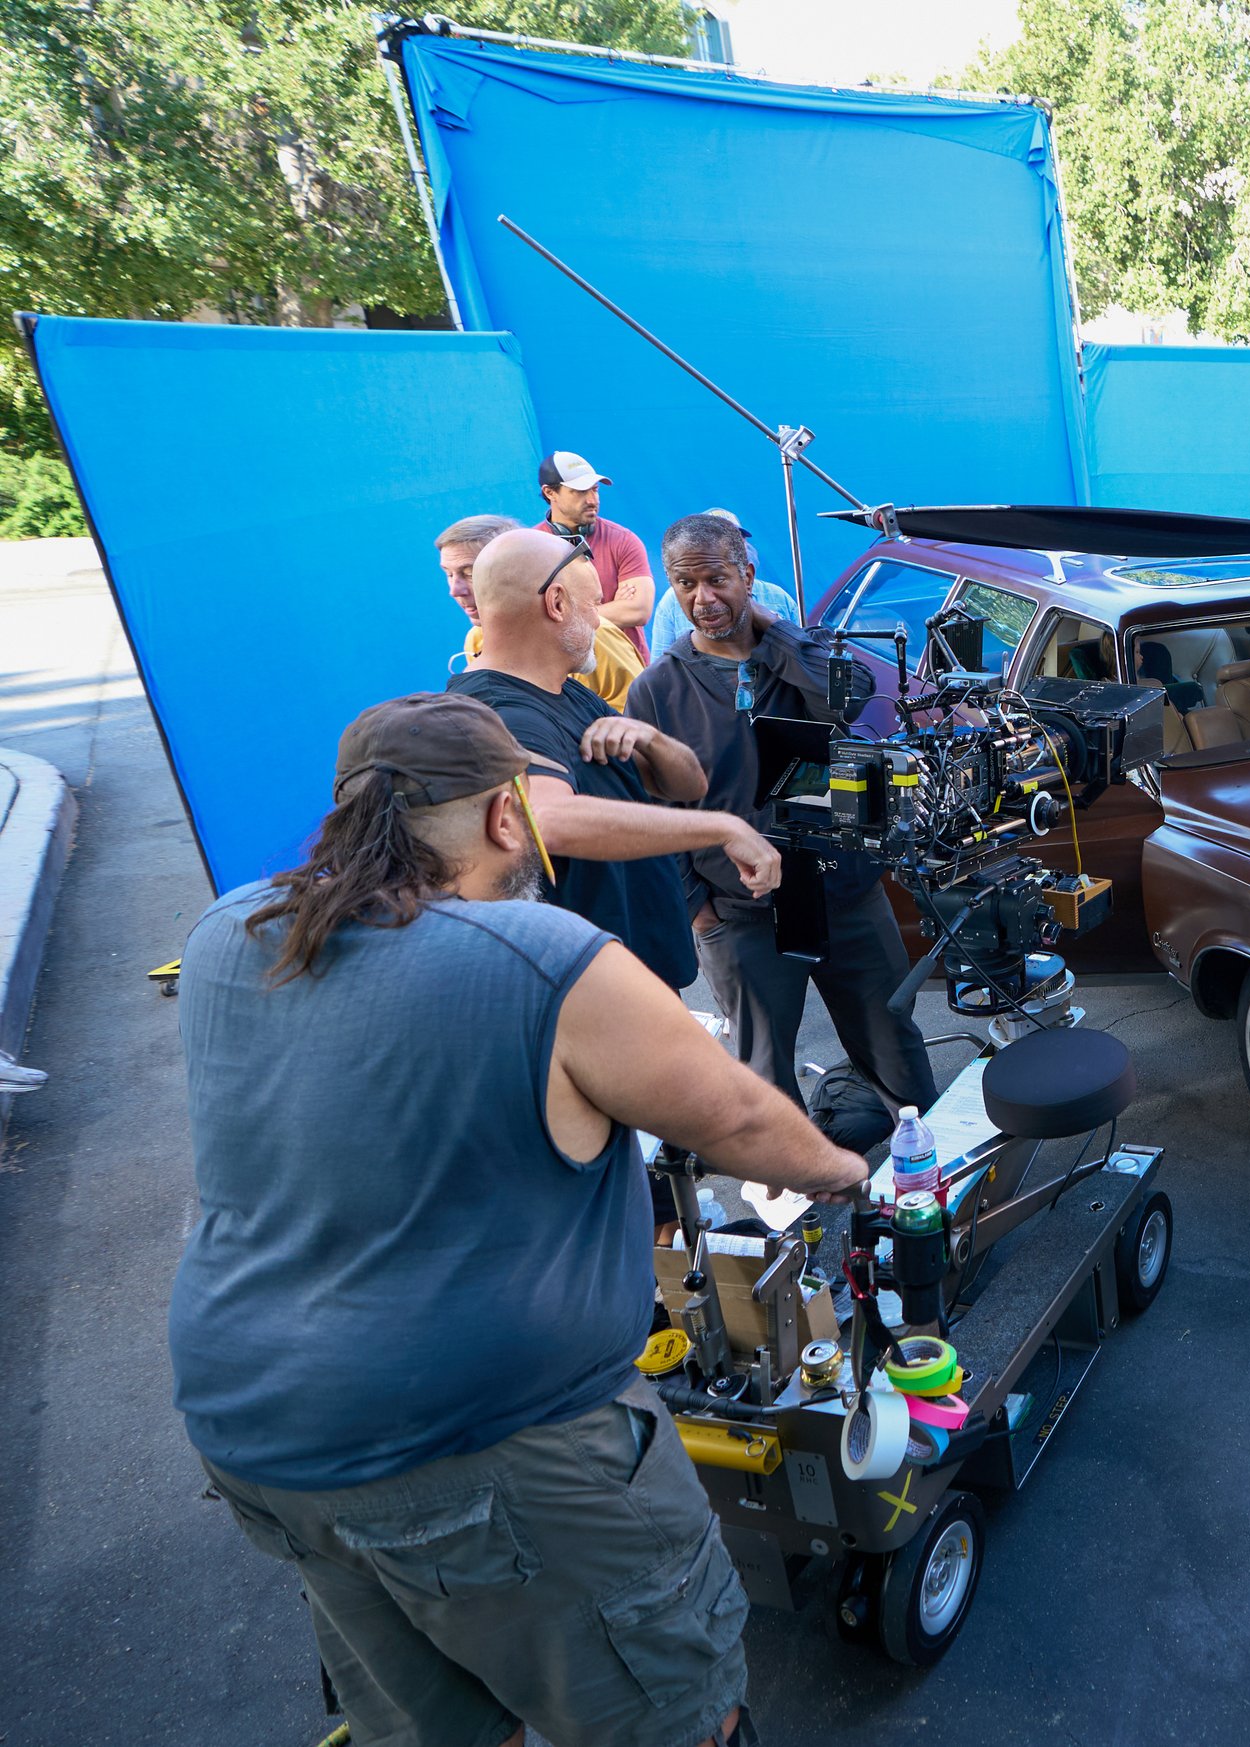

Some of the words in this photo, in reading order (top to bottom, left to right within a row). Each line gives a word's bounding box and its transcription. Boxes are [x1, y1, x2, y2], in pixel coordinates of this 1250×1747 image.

[1038, 1424, 1053, 1438] NO
[1049, 1395, 1068, 1419] STEP
[798, 1463, 816, 1477] 10
